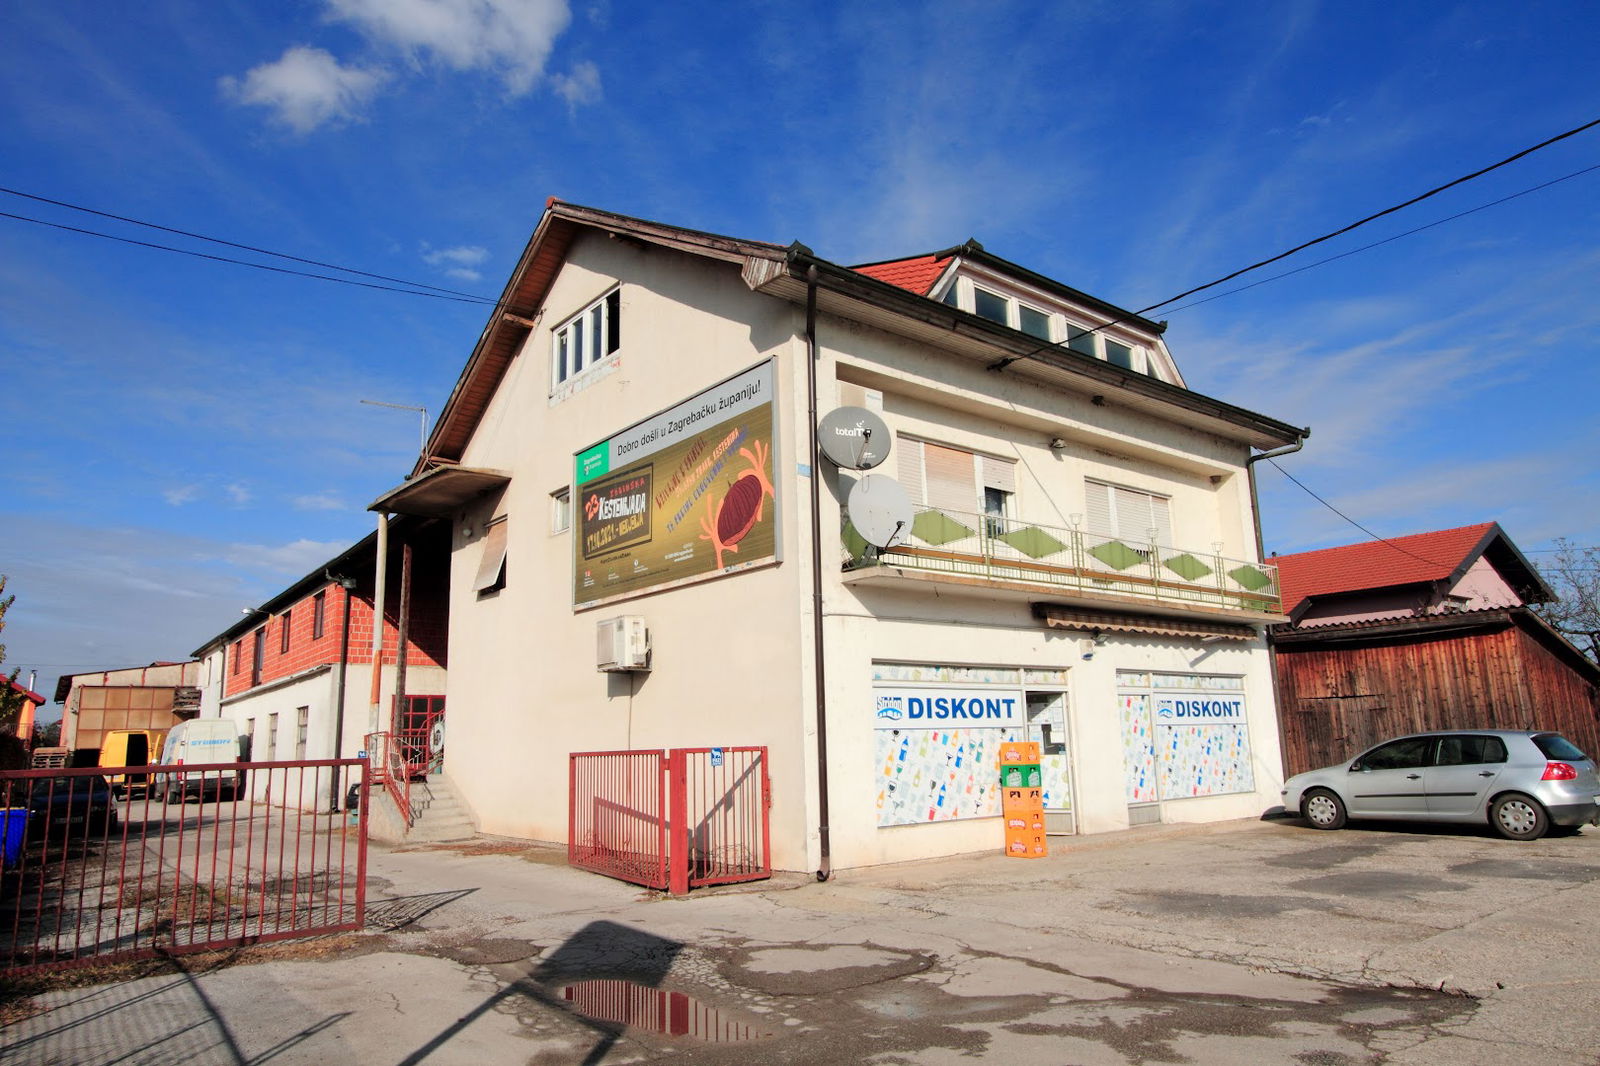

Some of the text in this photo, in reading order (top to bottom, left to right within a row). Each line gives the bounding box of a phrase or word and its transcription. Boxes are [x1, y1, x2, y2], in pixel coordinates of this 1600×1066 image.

[617, 379, 761, 456] Dobro došli u Zagrebačku županiju!
[908, 697, 1015, 719] DISKONT
[1175, 700, 1241, 717] DISKONT
